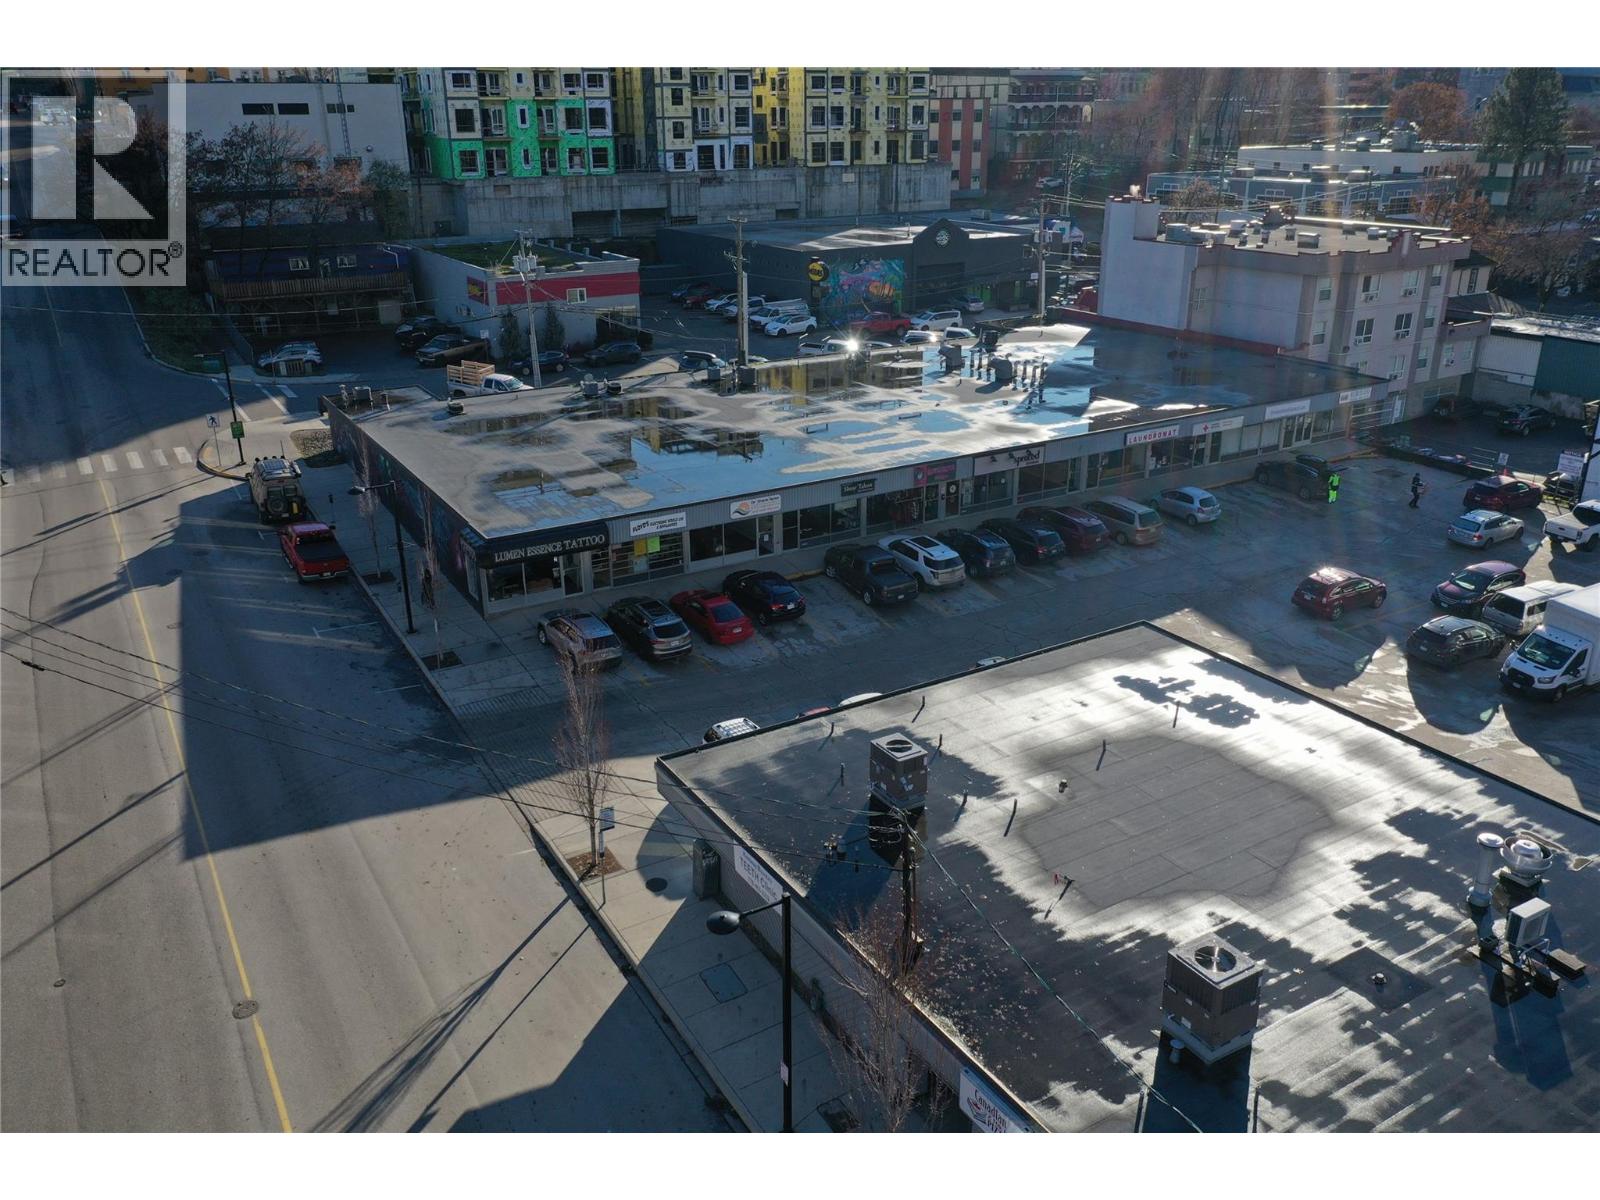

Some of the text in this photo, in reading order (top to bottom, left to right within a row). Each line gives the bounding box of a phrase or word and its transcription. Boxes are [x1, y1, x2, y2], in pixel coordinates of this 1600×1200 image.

[1129, 429, 1177, 444] LAUNDROMAT
[494, 534, 605, 562] LUMEN ESSENCE TATTOO
[974, 1089, 1007, 1129] Canadian
